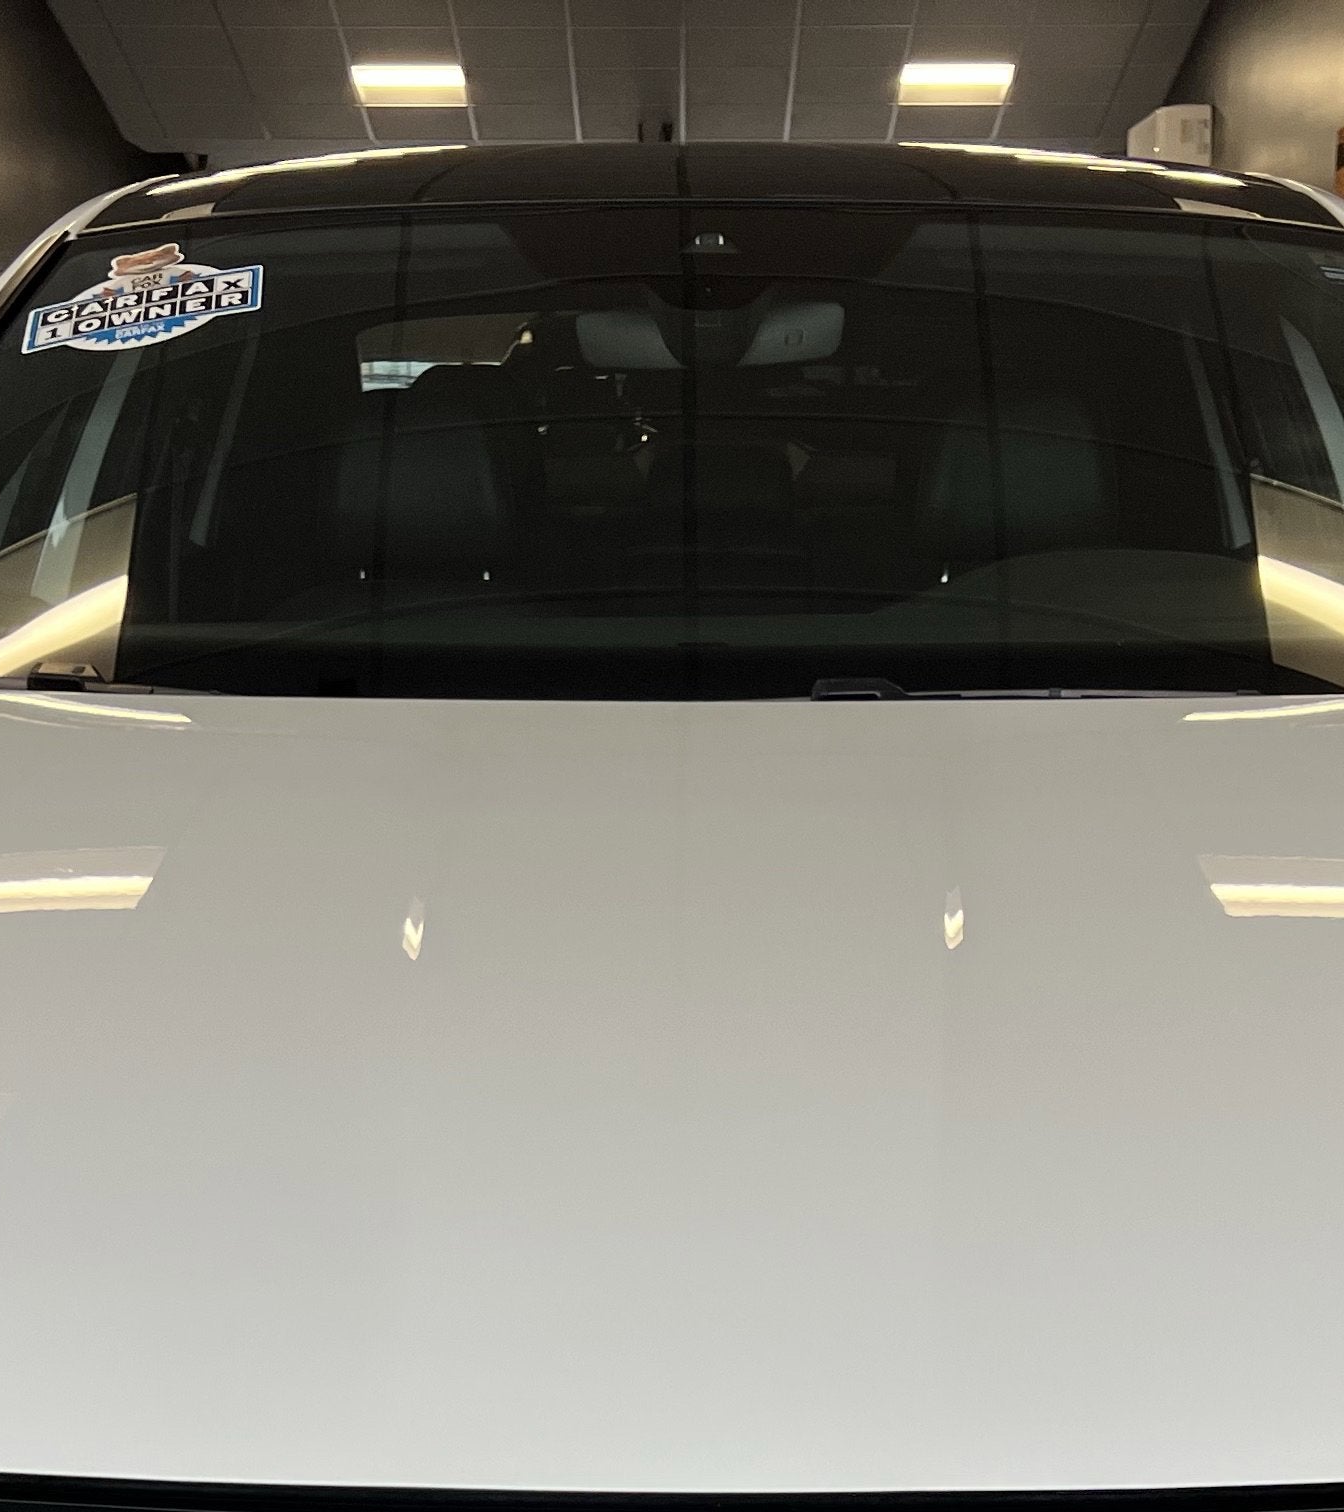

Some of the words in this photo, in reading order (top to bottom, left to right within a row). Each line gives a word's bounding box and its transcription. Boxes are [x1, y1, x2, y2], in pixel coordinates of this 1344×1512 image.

[46, 327, 65, 341] 1
[78, 292, 244, 332] OWNER
[47, 278, 244, 323] CARFAX
